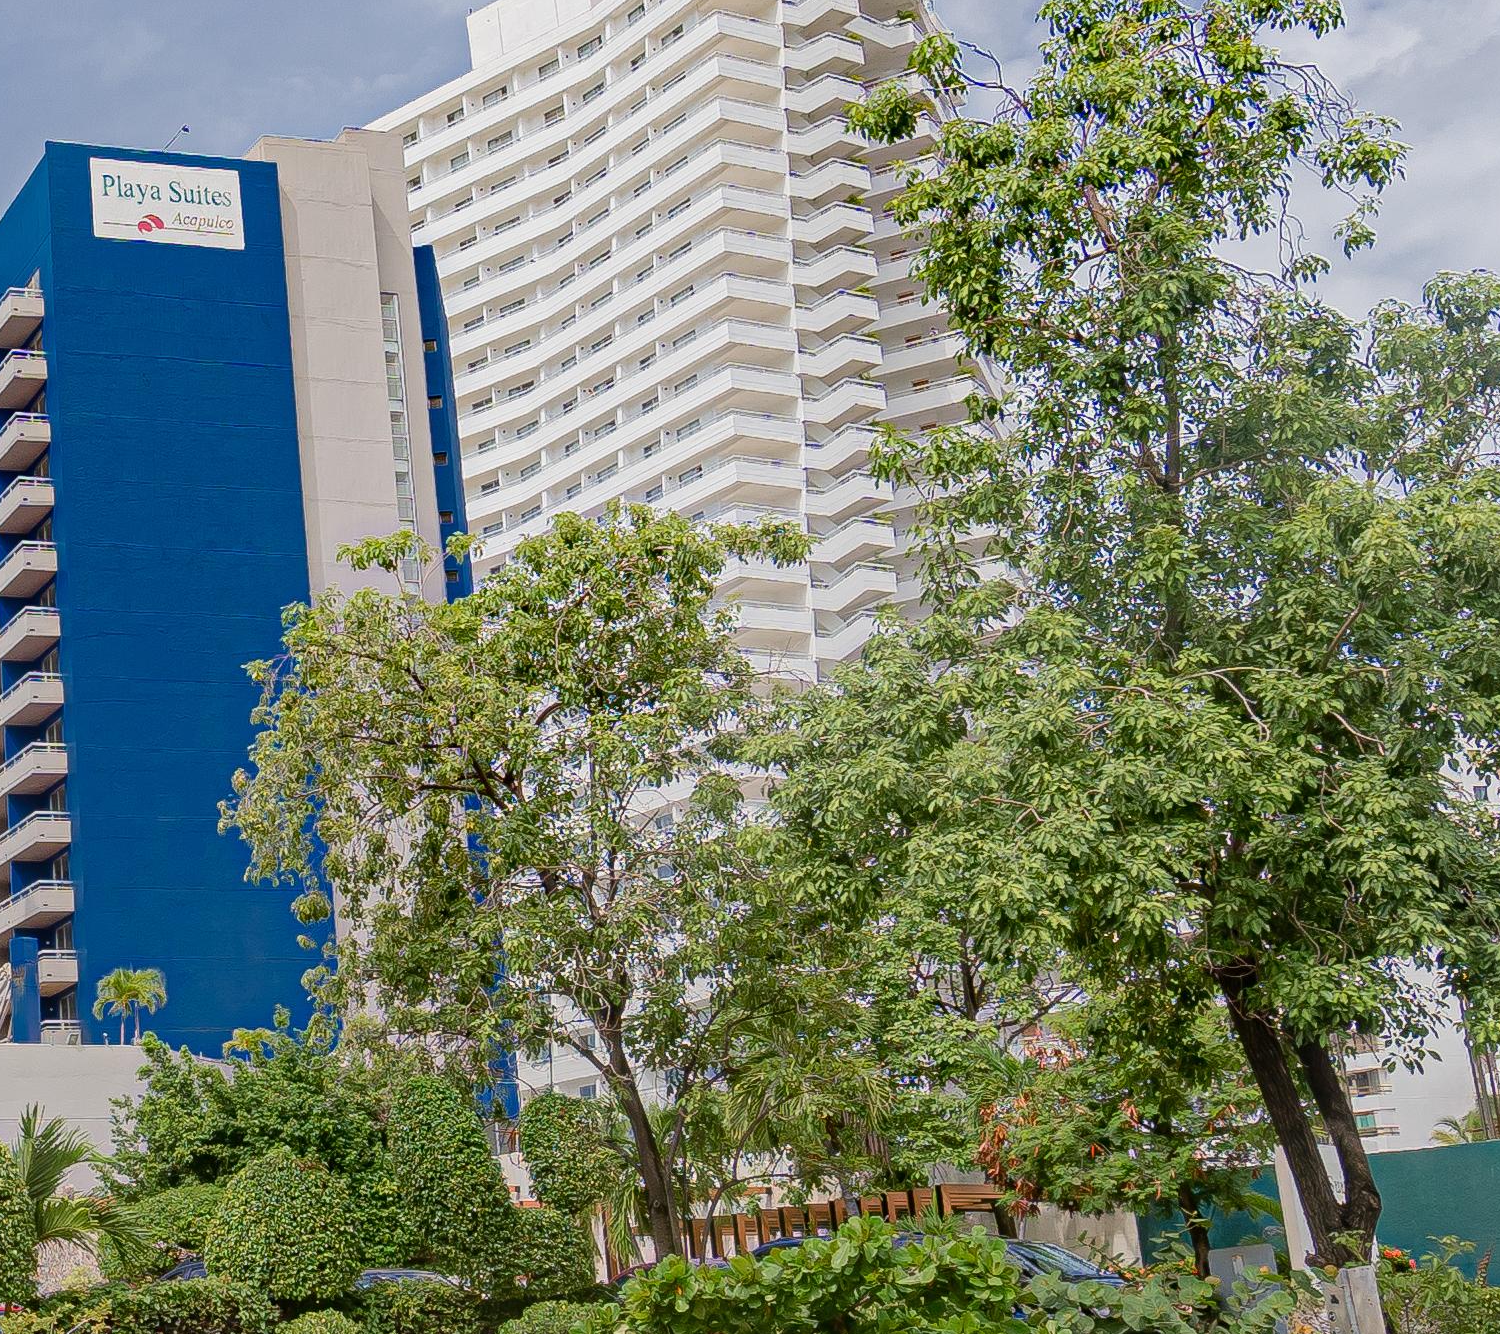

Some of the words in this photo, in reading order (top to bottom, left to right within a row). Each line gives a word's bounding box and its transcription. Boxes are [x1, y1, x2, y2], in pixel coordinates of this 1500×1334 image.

[101, 174, 162, 205] Playa
[169, 180, 233, 208] Suites
[172, 212, 234, 230] Acapulco
